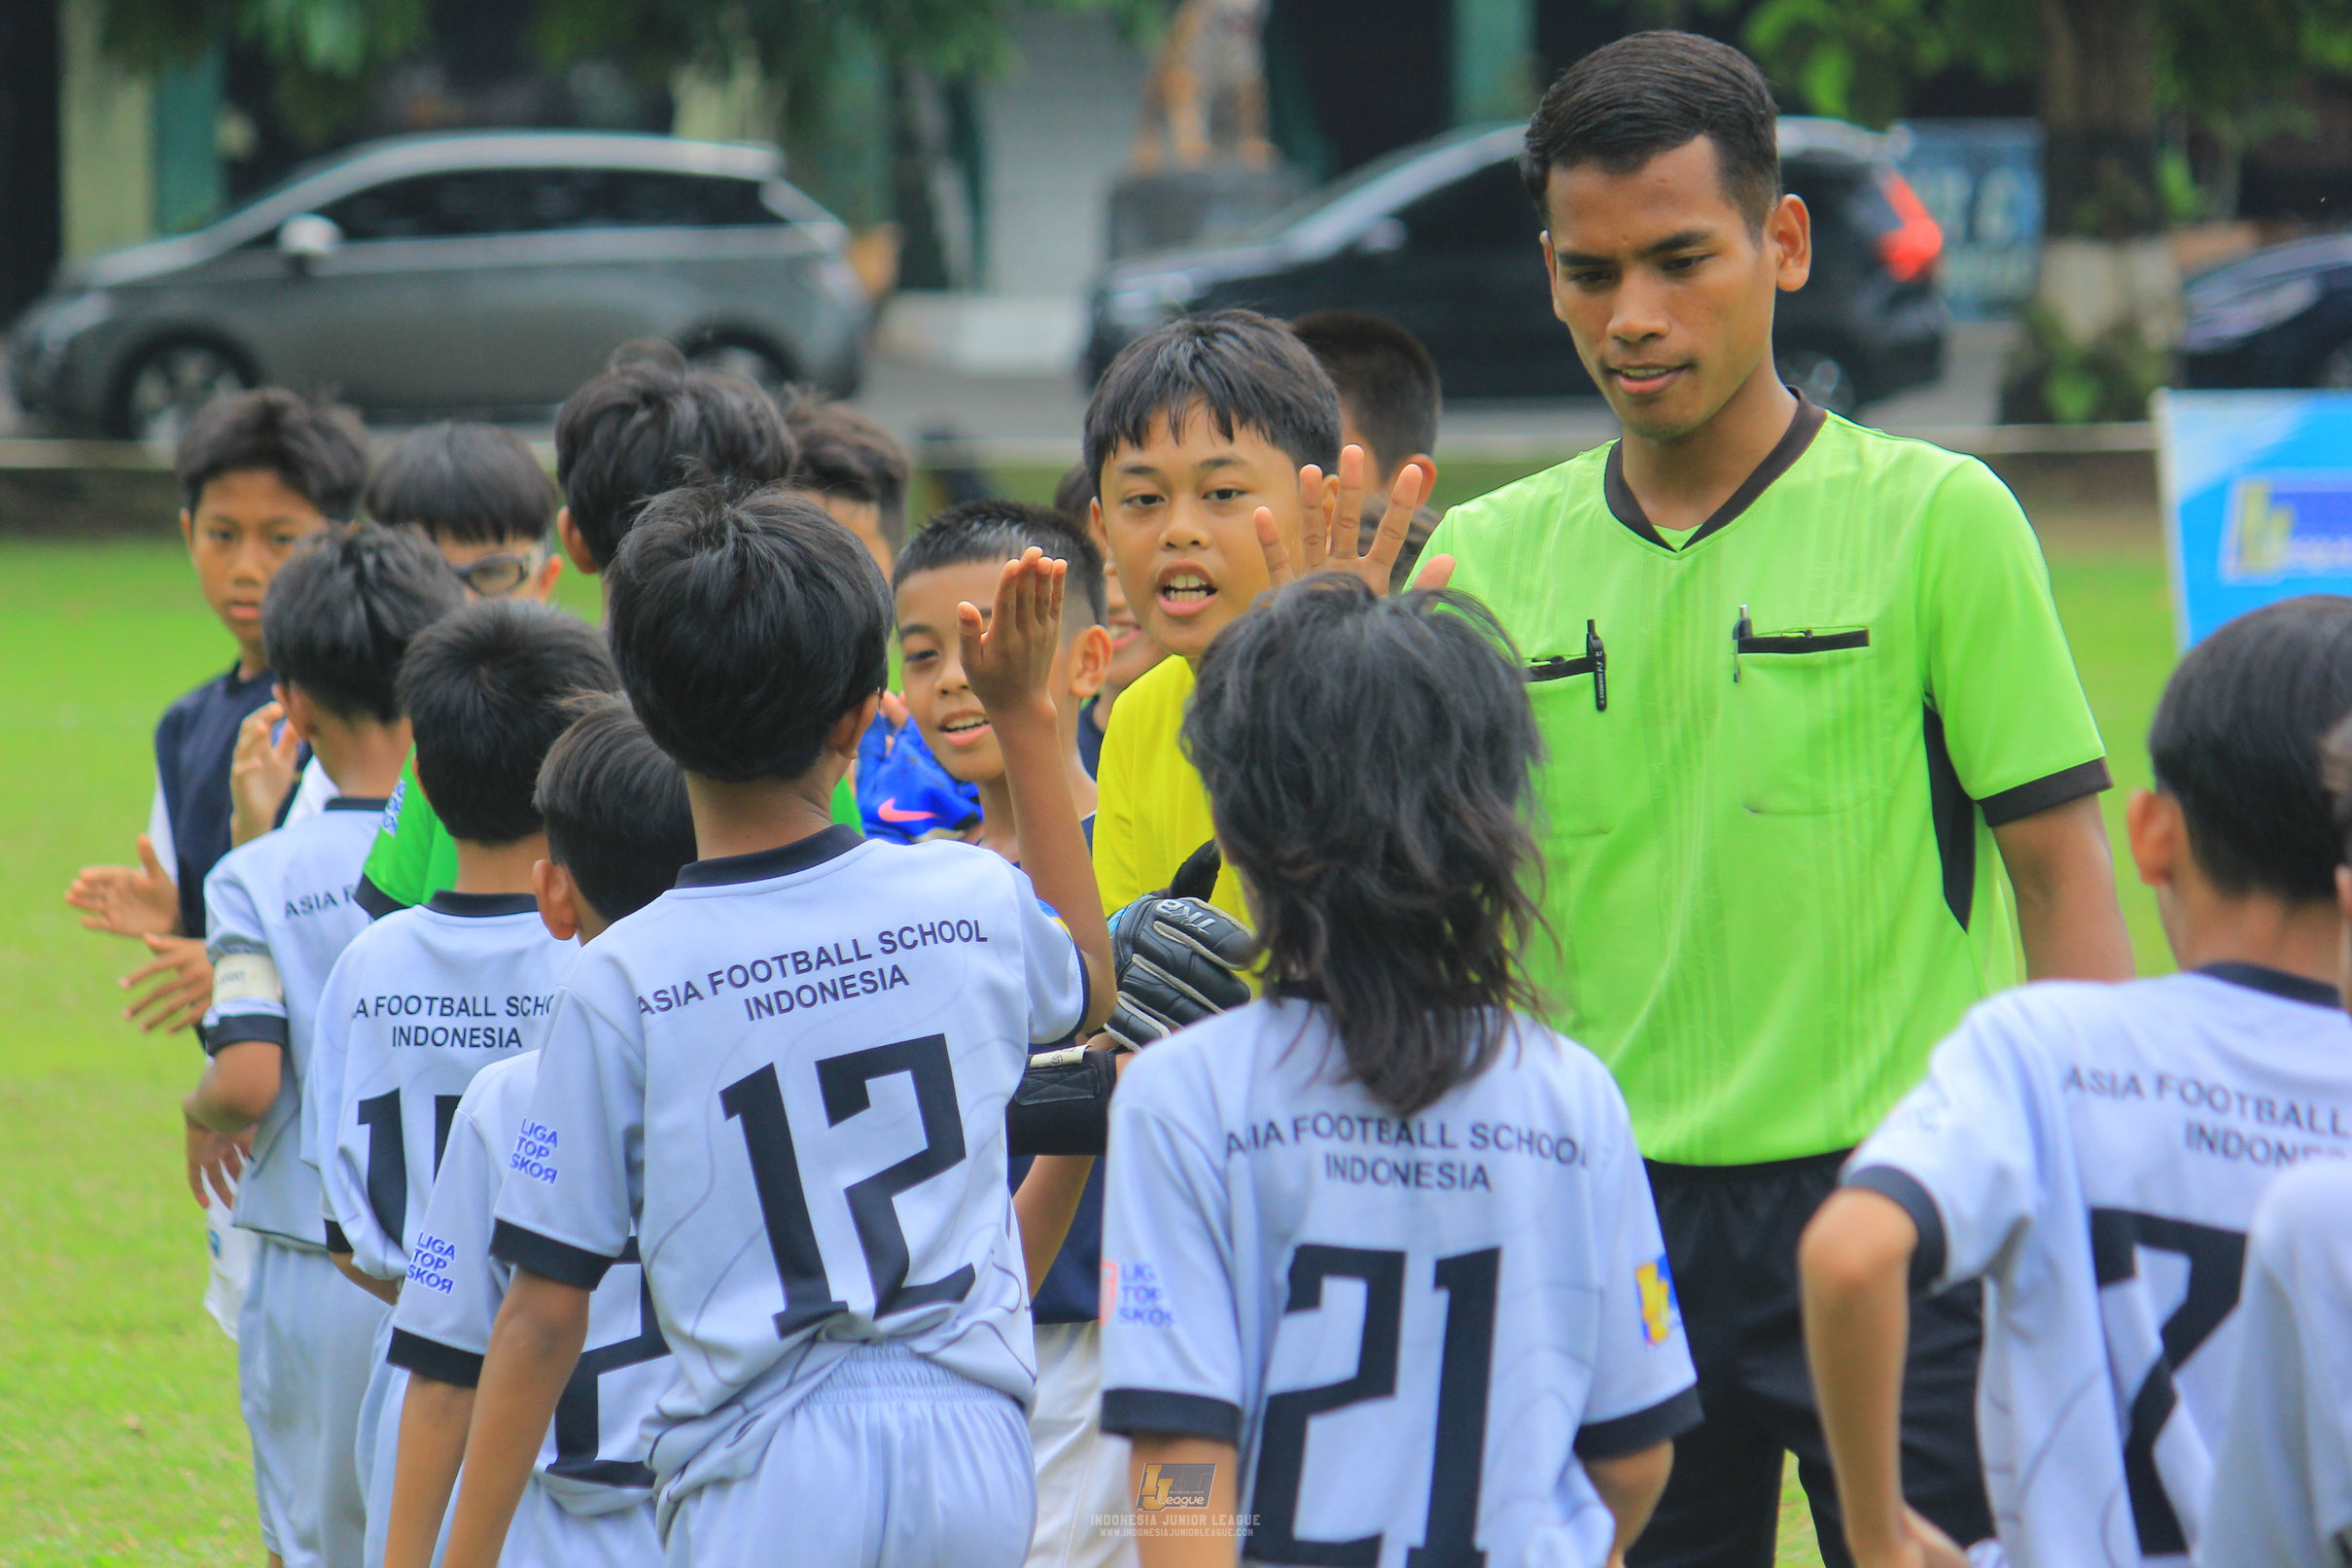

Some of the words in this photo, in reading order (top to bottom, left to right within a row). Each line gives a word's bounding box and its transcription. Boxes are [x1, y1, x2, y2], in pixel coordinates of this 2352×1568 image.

[285, 890, 338, 919] ASIA
[638, 981, 704, 1016] ASIA
[708, 938, 872, 996] FOOTBALL
[878, 920, 988, 955] SCHOOL
[374, 994, 497, 1017] FOOTBALL
[505, 995, 553, 1017] SCH
[744, 964, 909, 1022] INDONESIA
[392, 1026, 523, 1048] INDONESIA
[2062, 1064, 2145, 1100] ASIA
[2156, 1072, 2351, 1139] FOOTBALL
[515, 1137, 550, 1161] TOP
[520, 1119, 558, 1146] LIGA
[1225, 1121, 1285, 1159] AIA
[1292, 1111, 1458, 1149] FOOTBALL
[2186, 1120, 2346, 1168] INDON
[719, 1033, 976, 1340] 12
[1324, 1152, 1492, 1192] INDONESIA
[412, 1248, 447, 1272] TOP
[417, 1231, 456, 1260] LIGA
[1242, 1243, 1501, 1568] 21
